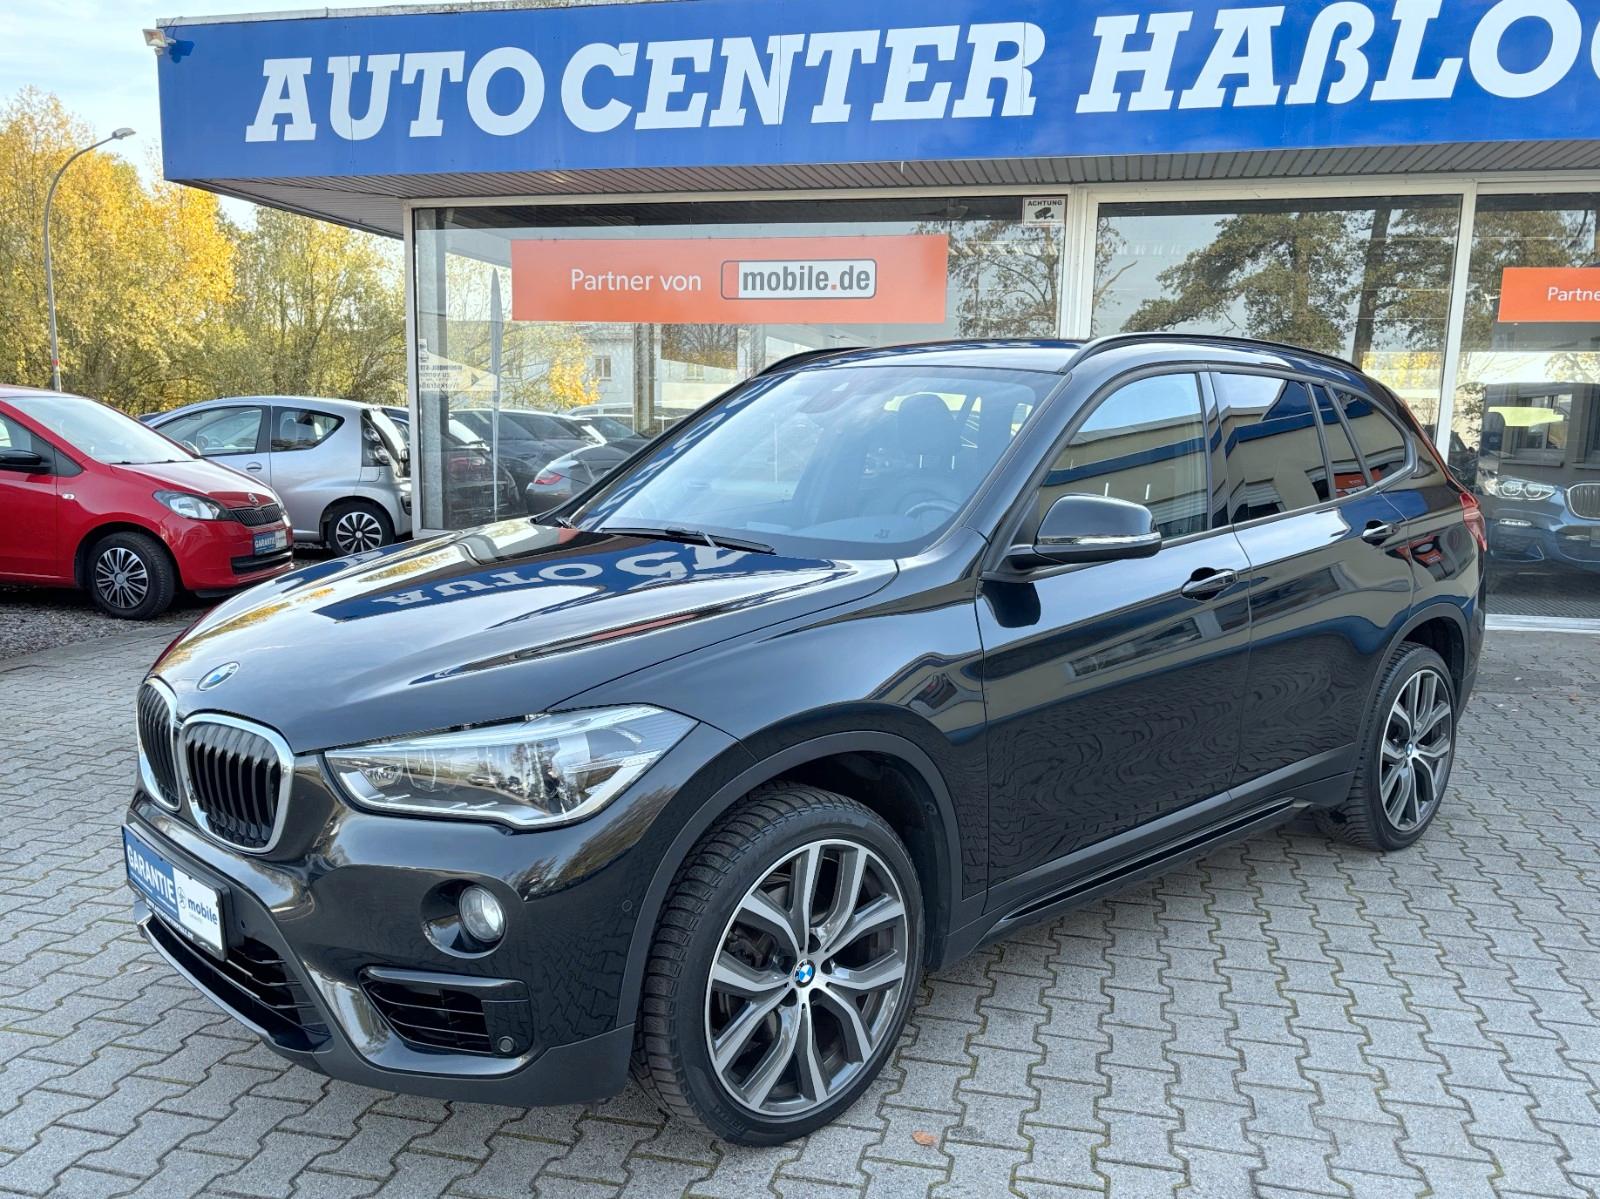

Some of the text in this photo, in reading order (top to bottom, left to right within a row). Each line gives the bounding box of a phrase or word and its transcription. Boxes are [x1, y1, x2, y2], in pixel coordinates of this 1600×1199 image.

[1075, 0, 1600, 113] HAßLO
[570, 265, 871, 291] Partner von mobile.de
[127, 844, 176, 904] GARANTIE
[187, 896, 218, 926] mobile
